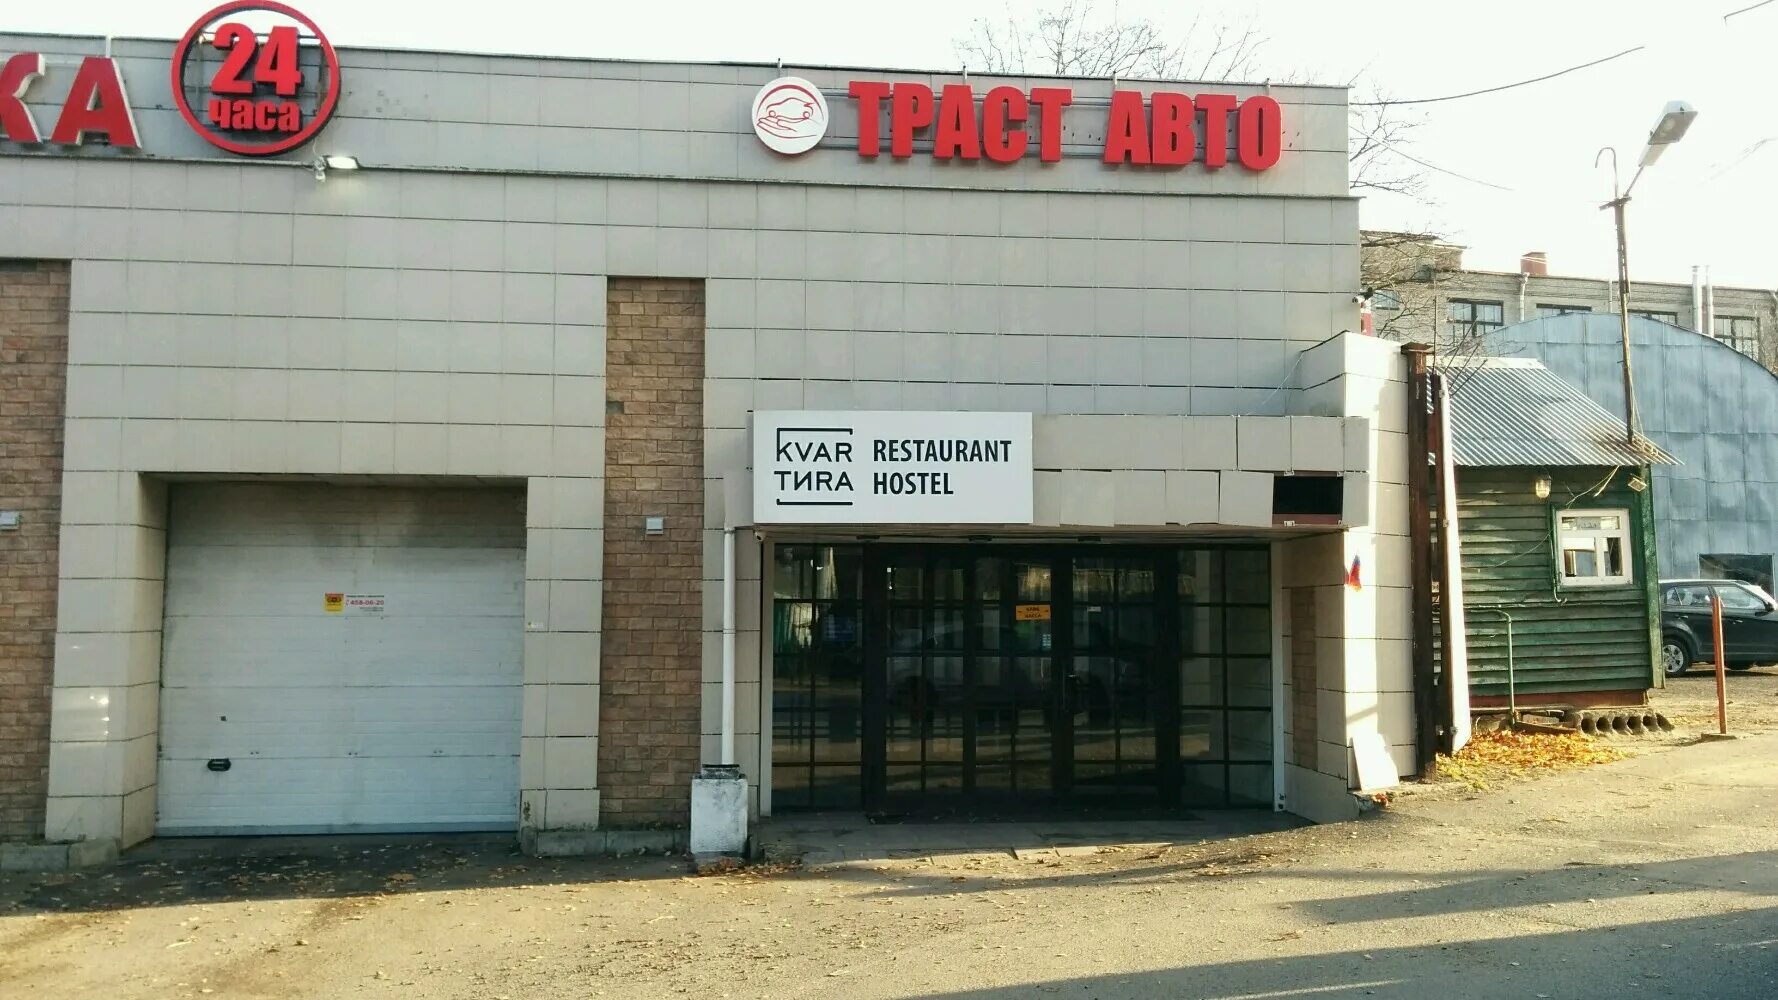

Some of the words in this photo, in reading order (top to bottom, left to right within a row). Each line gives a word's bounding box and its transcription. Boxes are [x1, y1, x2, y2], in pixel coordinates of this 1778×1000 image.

[211, 22, 304, 96] 24
[208, 99, 300, 133] часа
[848, 80, 1073, 163] ТРАСТ
[1103, 90, 1282, 171] АВТО
[776, 441, 853, 463] KVAR
[873, 439, 1012, 462] RESTAURANT
[873, 472, 954, 495] HOSTEL
